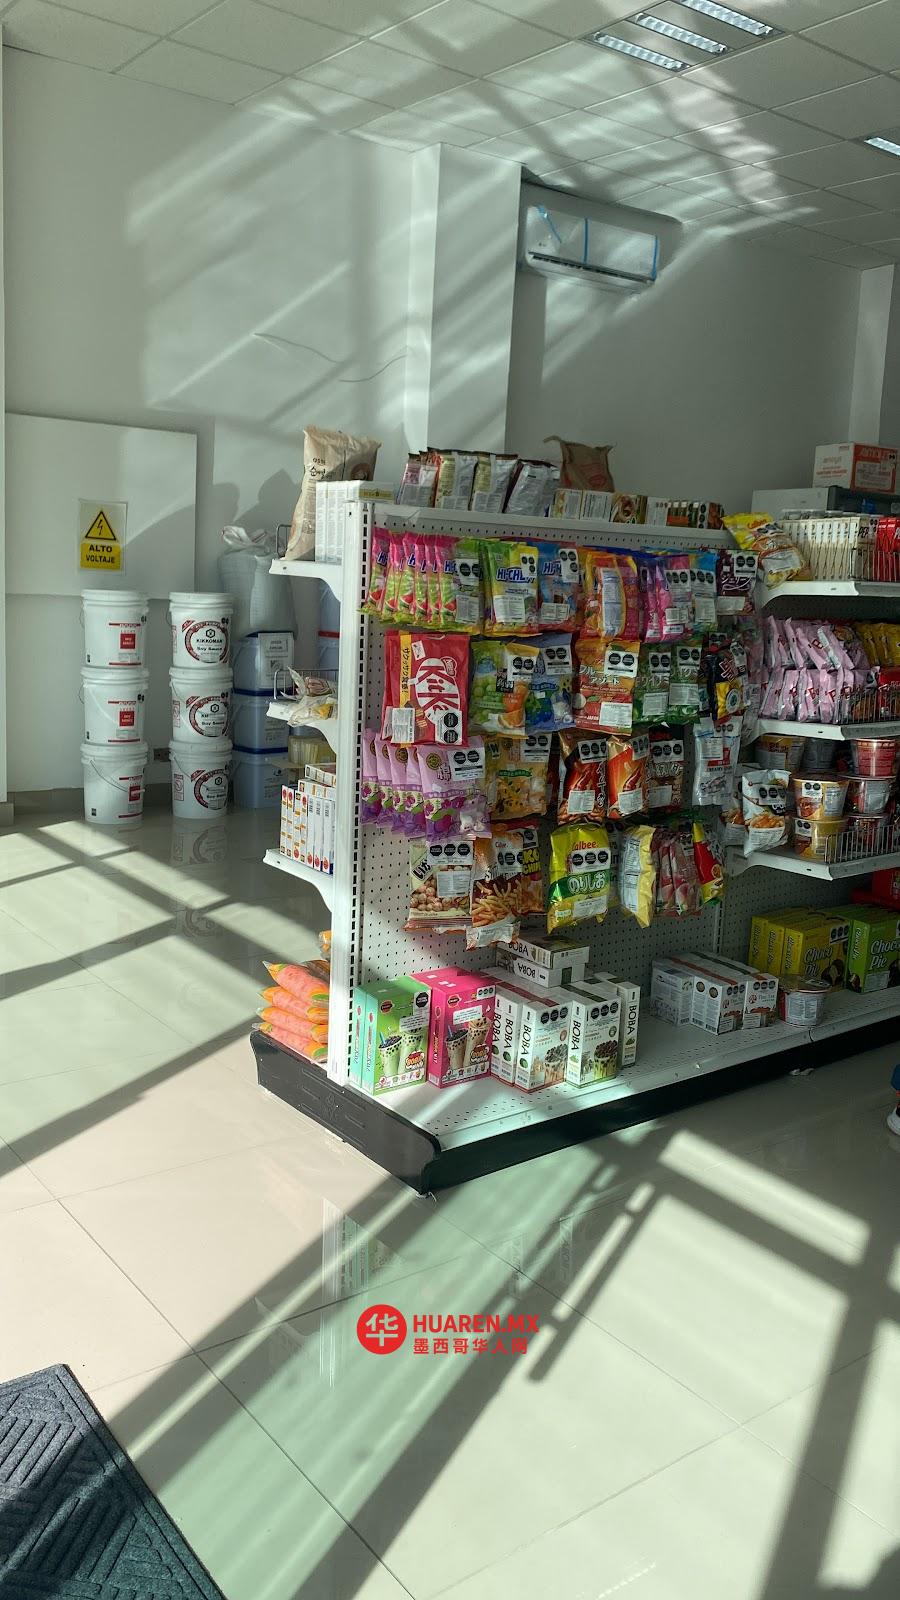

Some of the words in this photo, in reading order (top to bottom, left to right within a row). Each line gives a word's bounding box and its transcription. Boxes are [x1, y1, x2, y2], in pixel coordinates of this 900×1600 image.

[89, 544, 113, 553] ALTO
[86, 554, 115, 564] VOLTAJE
[573, 841, 597, 851] albee
[568, 871, 606, 894] のりしお
[804, 947, 834, 963] Choco
[868, 955, 887, 970] Pie
[518, 962, 536, 979] BOBA
[626, 1004, 637, 1035] BOBA
[503, 1018, 514, 1050] BOBA
[520, 1024, 532, 1056] BOBA
[571, 1020, 582, 1051] BOBA
